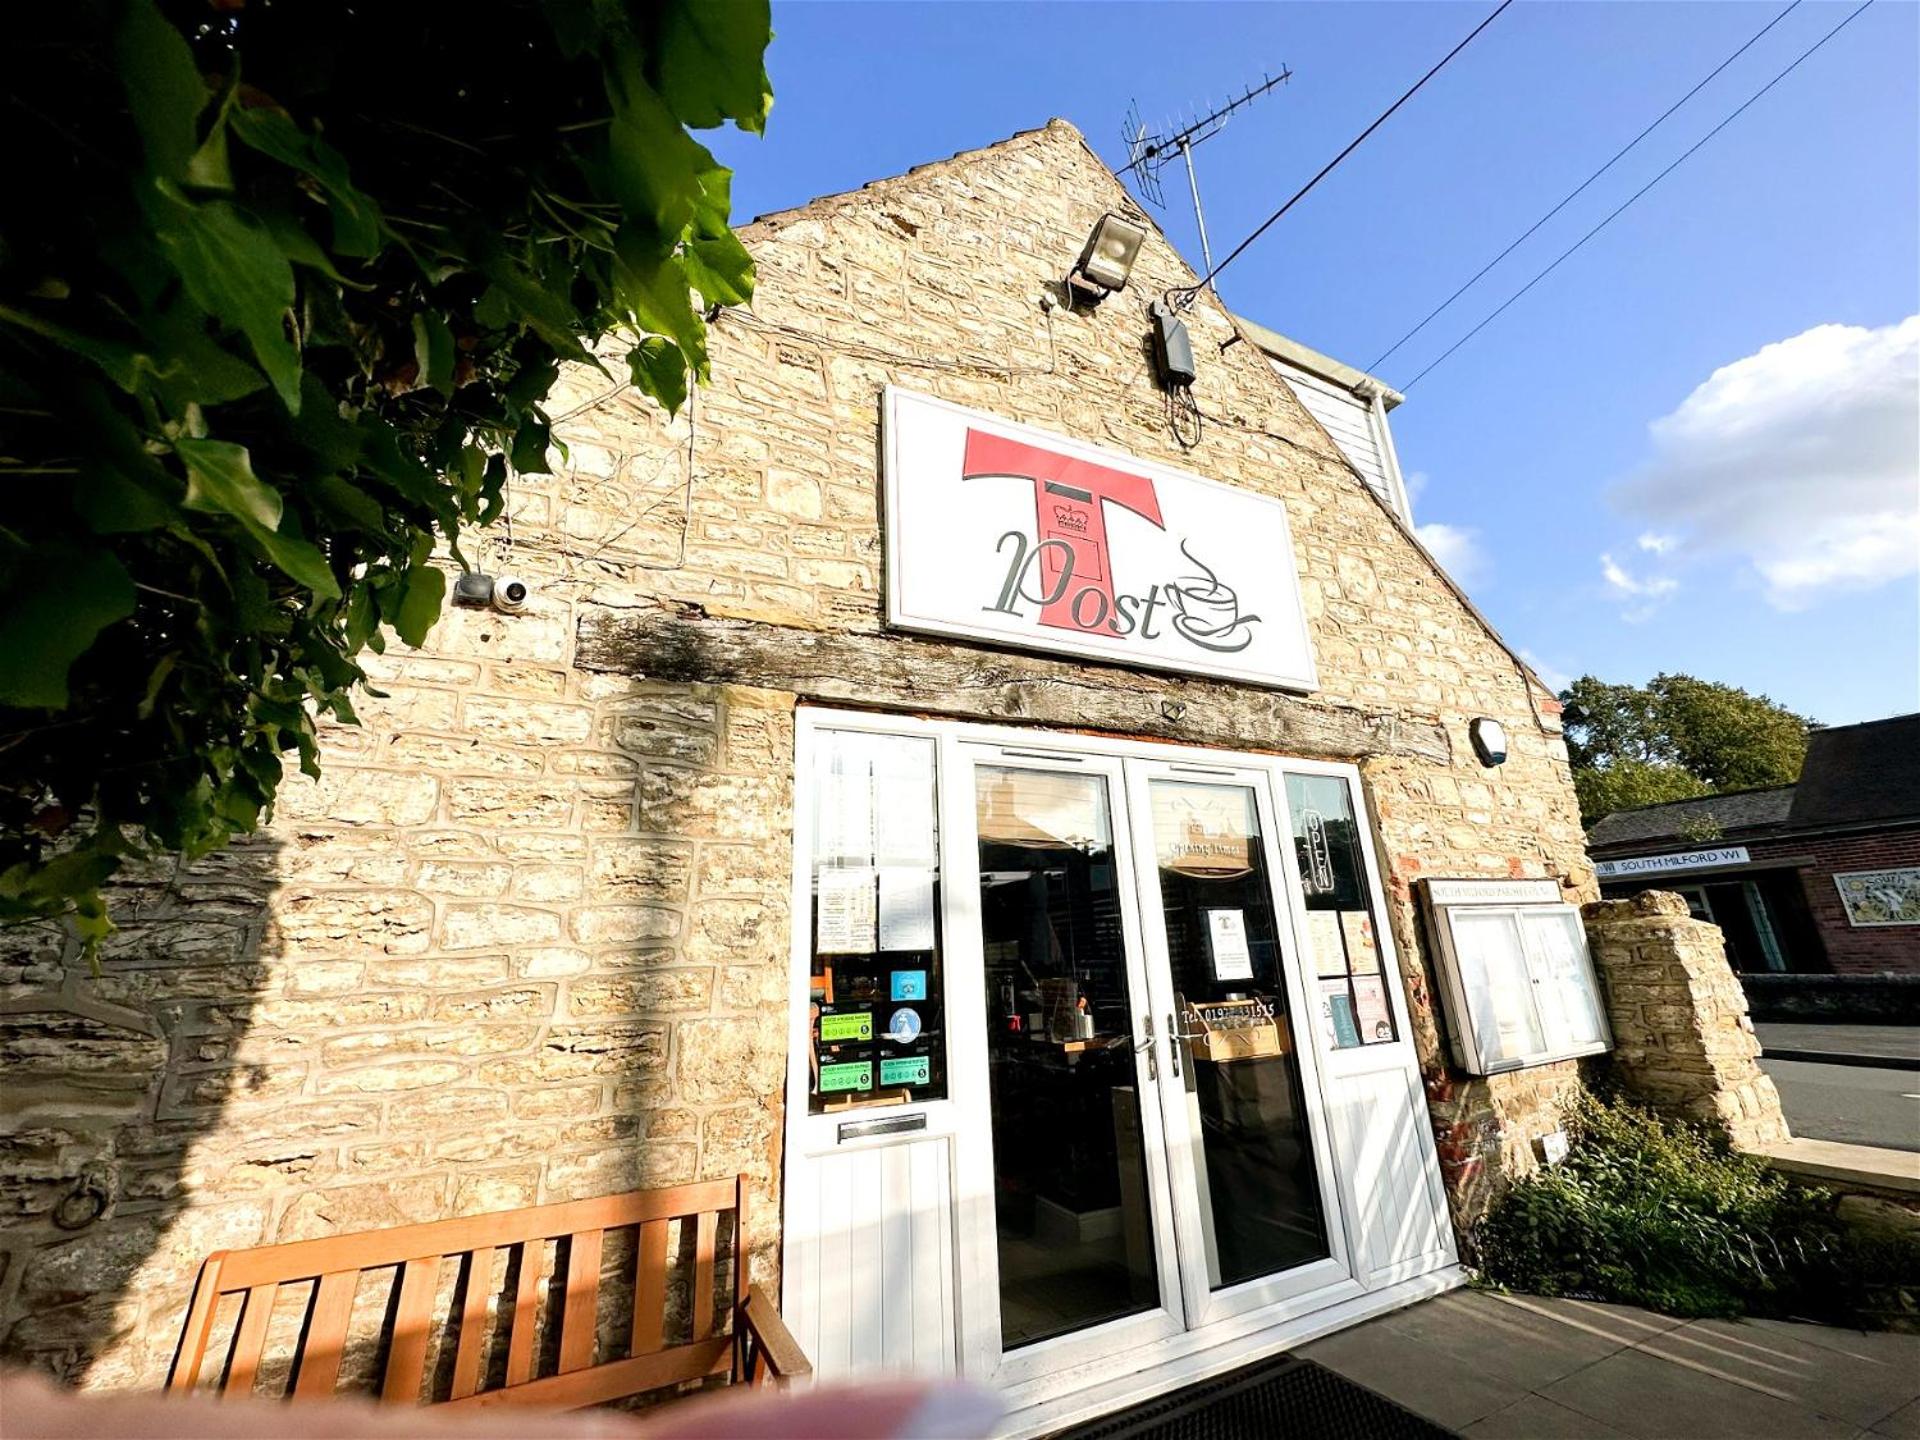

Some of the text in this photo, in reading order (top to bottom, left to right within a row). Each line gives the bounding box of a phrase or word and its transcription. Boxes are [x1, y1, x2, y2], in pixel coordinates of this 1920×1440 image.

[962, 426, 1166, 639] T
[981, 530, 1167, 640] Post
[1309, 814, 1330, 888] OPEN
[1621, 860, 1662, 871] SOUTH
[1664, 852, 1718, 867] MILFORD
[1720, 850, 1740, 860] WI
